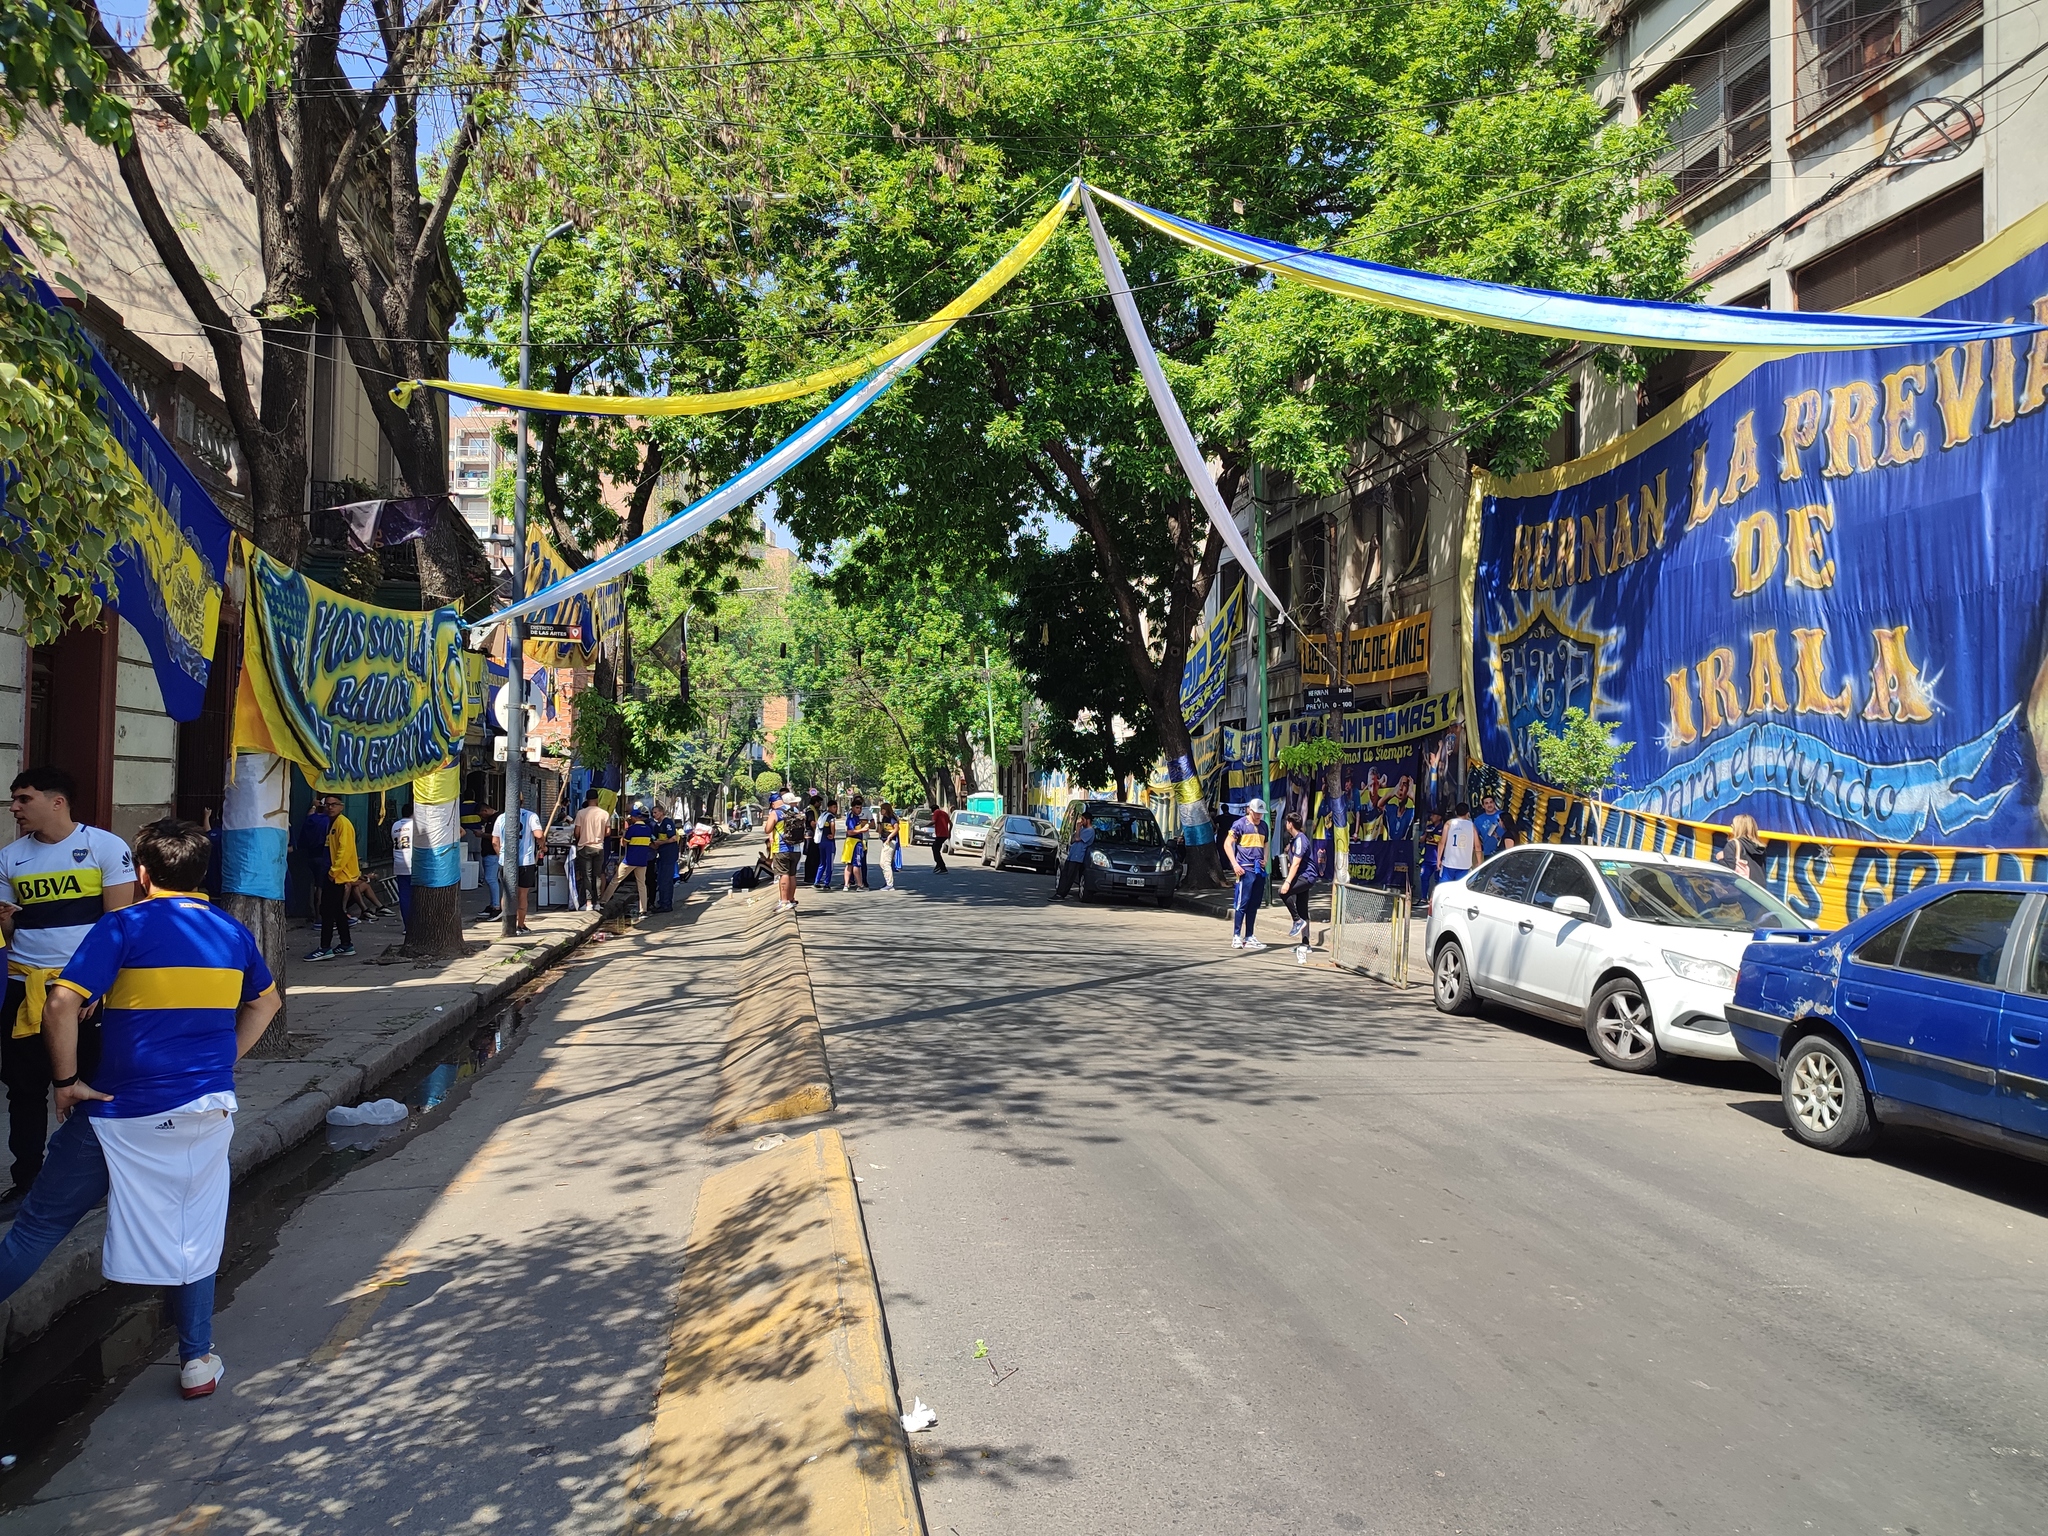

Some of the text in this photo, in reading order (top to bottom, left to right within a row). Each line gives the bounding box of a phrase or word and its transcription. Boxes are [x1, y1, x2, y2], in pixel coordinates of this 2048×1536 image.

[1508, 471, 1669, 592] HERNAN
[1684, 410, 1761, 532] LA
[1731, 502, 1837, 599] DE
[308, 600, 366, 690] VOS
[368, 613, 405, 664] SOS
[1372, 633, 1386, 672] DE
[1387, 622, 1426, 670] LANUS
[1305, 702, 1330, 710] PREVIA
[1308, 689, 1329, 697] HERNAN
[1347, 711, 1397, 744] MITAD
[1398, 699, 1438, 736] MAS
[1665, 626, 1933, 749] IRALA
[1638, 757, 1720, 820] para
[1731, 728, 1757, 790] el
[17, 874, 82, 900] BBVA
